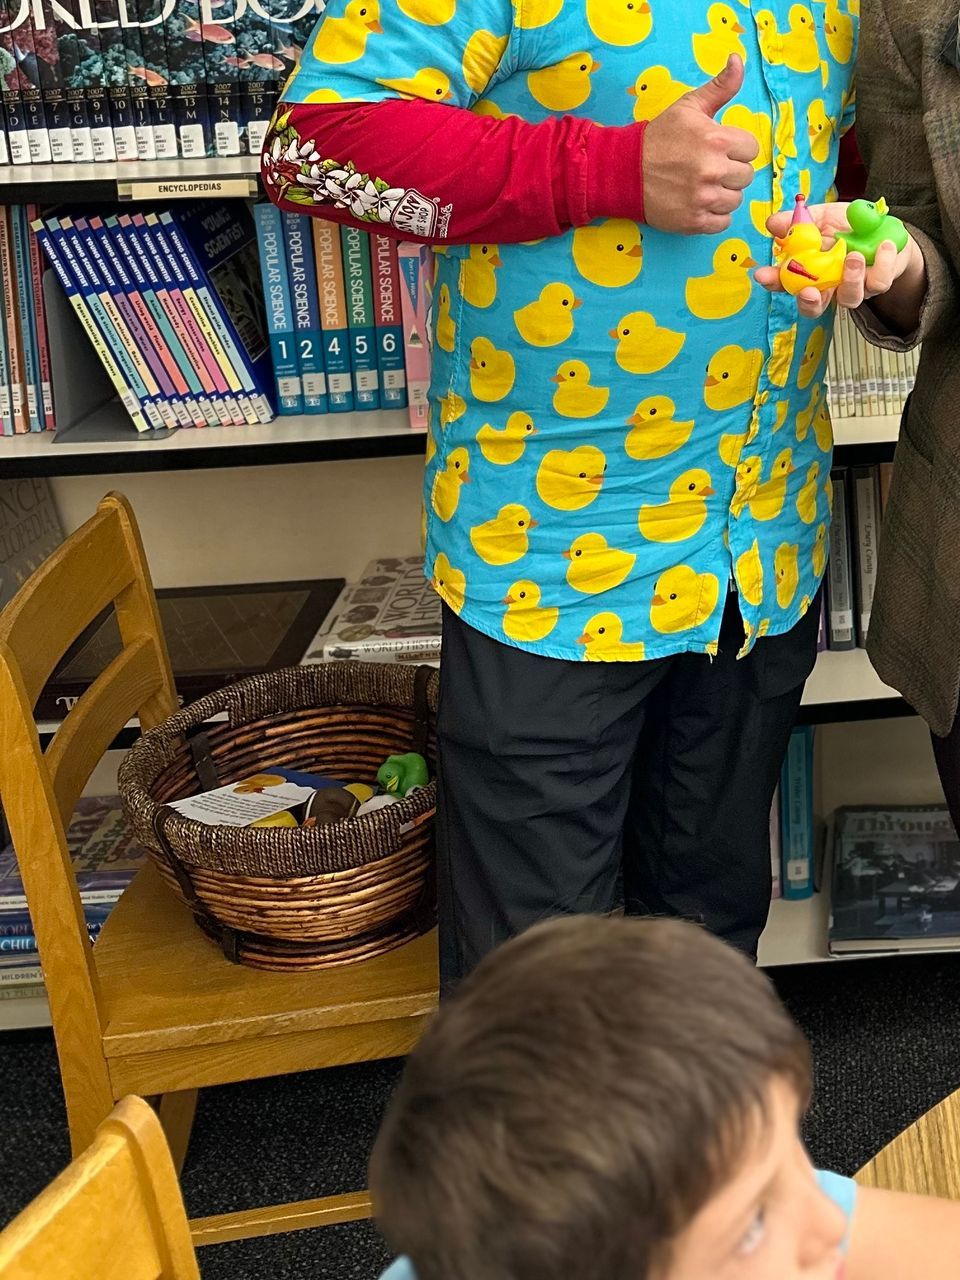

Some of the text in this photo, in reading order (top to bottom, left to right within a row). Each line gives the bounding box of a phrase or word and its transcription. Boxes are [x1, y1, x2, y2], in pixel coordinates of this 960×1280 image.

[115, 101, 125, 109] 10
[135, 101, 144, 109] 11
[156, 100, 166, 108] 12
[185, 98, 195, 106] 13
[252, 95, 262, 103] 15
[9, 105, 15, 113] 5
[30, 104, 36, 112] 6
[52, 103, 57, 111] 7
[74, 103, 80, 111] 8
[94, 102, 100, 110] 9
[158, 183, 222, 193] ENCYCLOPEDIAS
[170, 231, 199, 281] YOUNG SCIENTIST
[42, 238, 72, 287] YOUNG SCIENTIST
[264, 233, 286, 329] POPULAR SCIENCE
[288, 232, 310, 328] POPULAR SCIENCE
[319, 228, 338, 326] POPULAR SCIENCE
[380, 278, 394, 322] SCIENCE
[300, 340, 313, 358] 2
[328, 337, 340, 355] 4
[355, 336, 368, 354] 5
[382, 334, 396, 352] 6
[279, 341, 288, 359] 1
[362, 641, 403, 653] WORLD
